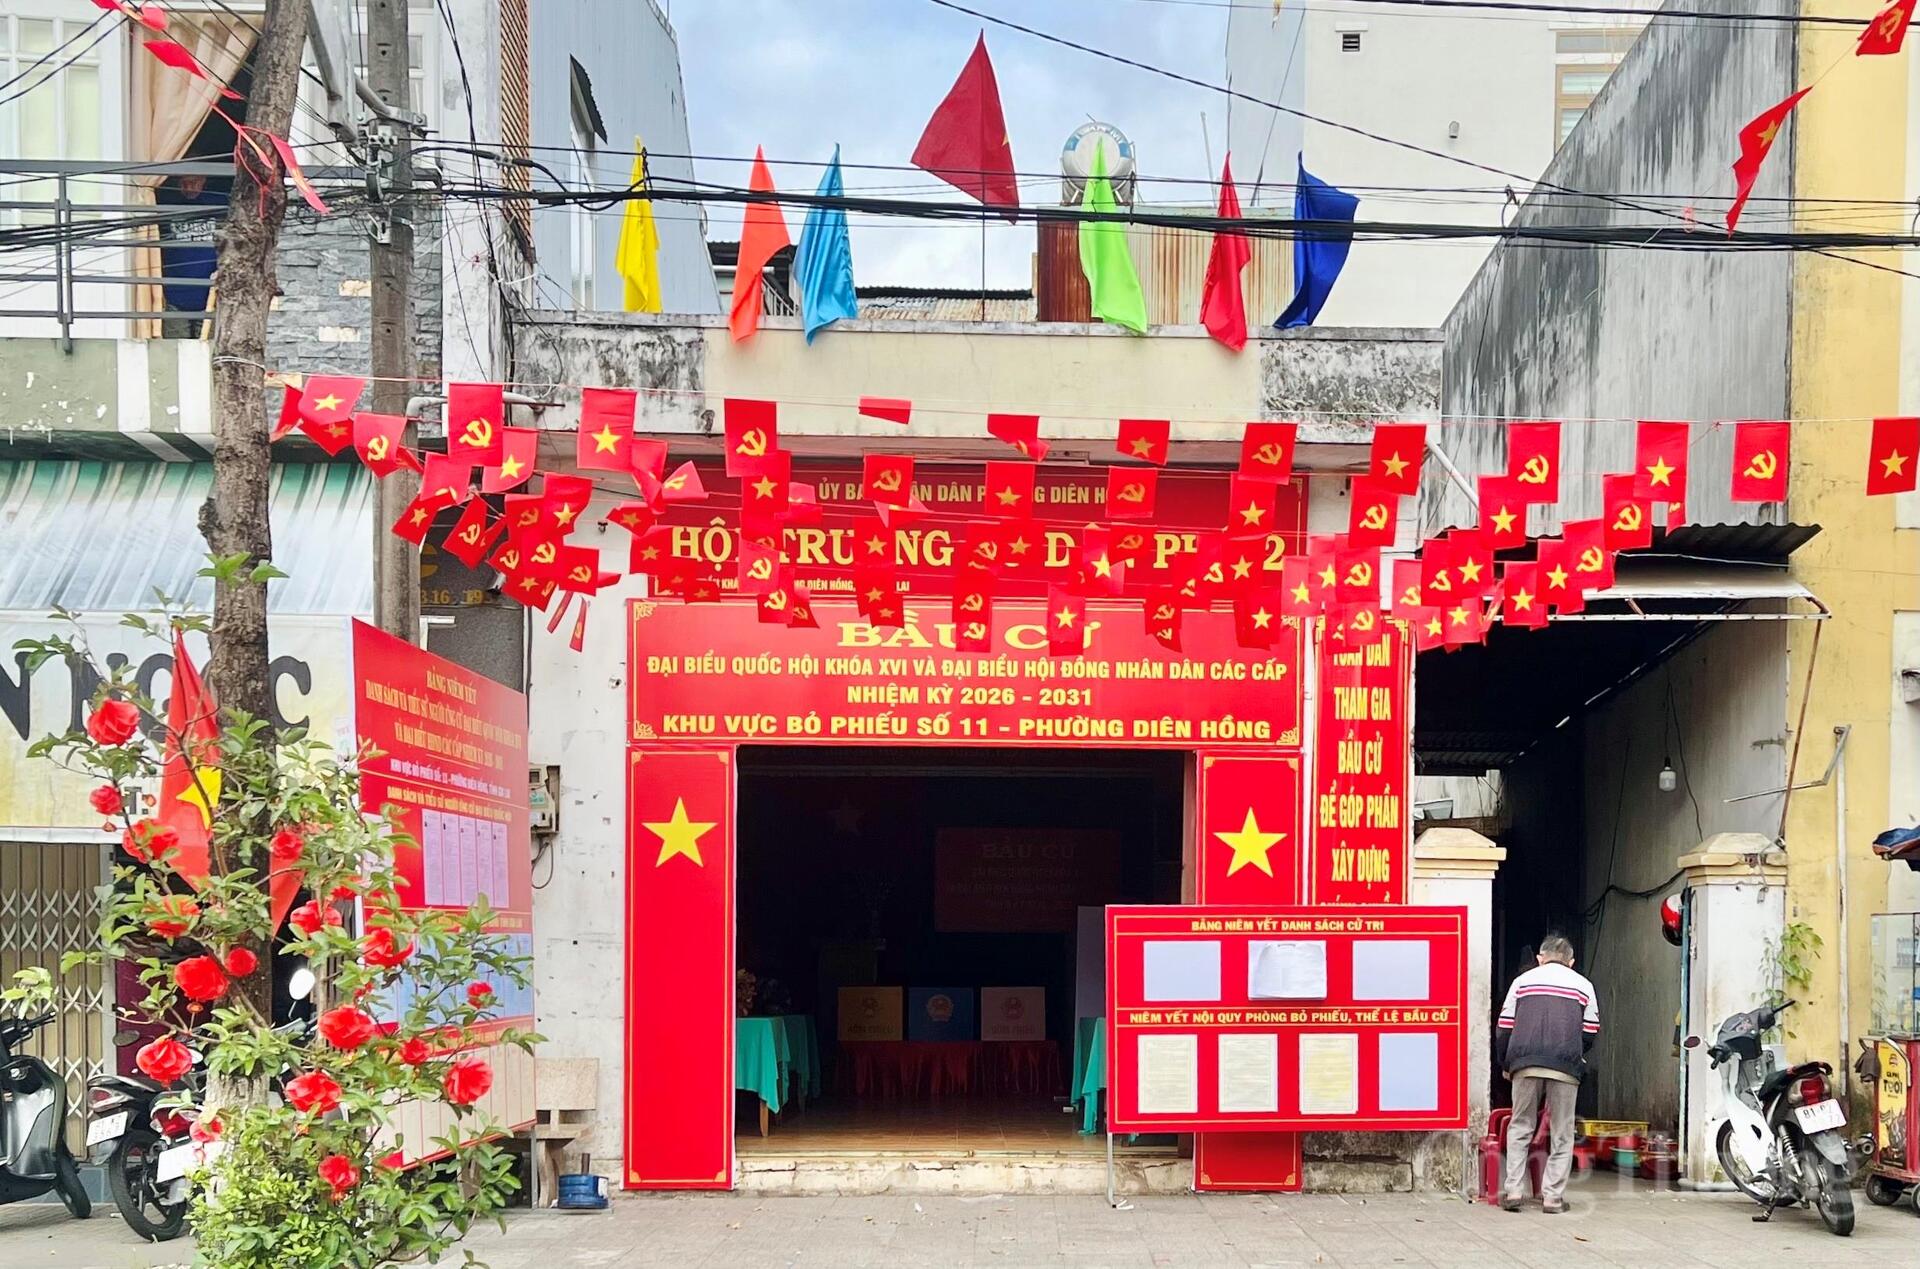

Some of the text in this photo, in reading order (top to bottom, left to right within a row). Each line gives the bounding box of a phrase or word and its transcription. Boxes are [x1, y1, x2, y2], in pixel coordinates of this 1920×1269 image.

[819, 477, 841, 500] ỦY
[845, 484, 864, 500] BA
[938, 482, 967, 502] DÂN
[1050, 484, 1089, 504] DIÊN
[672, 516, 741, 572] HỘ
[1263, 534, 1286, 570] 2
[896, 581, 910, 592] LAI
[646, 649, 1288, 682] ĐẠI BIỂU QUỐC HỘI KHÓA XVI VÀ ĐẠI BIỂU HỘI ĐỒNG NHÂN DÂN CÁC CẤP
[847, 683, 919, 707] NHIỆM
[926, 684, 954, 704] KỲ
[960, 687, 1015, 706] 2026
[1039, 688, 1092, 706] 2031
[1333, 687, 1392, 720] THAM GIA
[663, 715, 716, 734] KHU
[724, 713, 777, 737] VỰC
[786, 711, 822, 735] BỎ
[830, 710, 908, 735] PHIẾU
[917, 711, 952, 736] SỐ
[960, 717, 989, 736] 11
[1019, 715, 1124, 737] PHƯỜNG
[1133, 716, 1191, 738] DIÊN
[1200, 713, 1271, 739] HỒNG
[1338, 729, 1383, 775] BẦU CỬ
[1320, 780, 1399, 829] ĐỂ GÓP PHẦN
[1331, 840, 1390, 890] XÂY DỰNG
[1191, 917, 1384, 931] BẢNG NIÊM YẾT DANH SÁCH CỬ TRI
[1130, 1008, 1449, 1024] NIÊM YẾT NỘI QUY PHÒNG BỎ PHIẾU, THỂ LỆ BẦU CỬ
